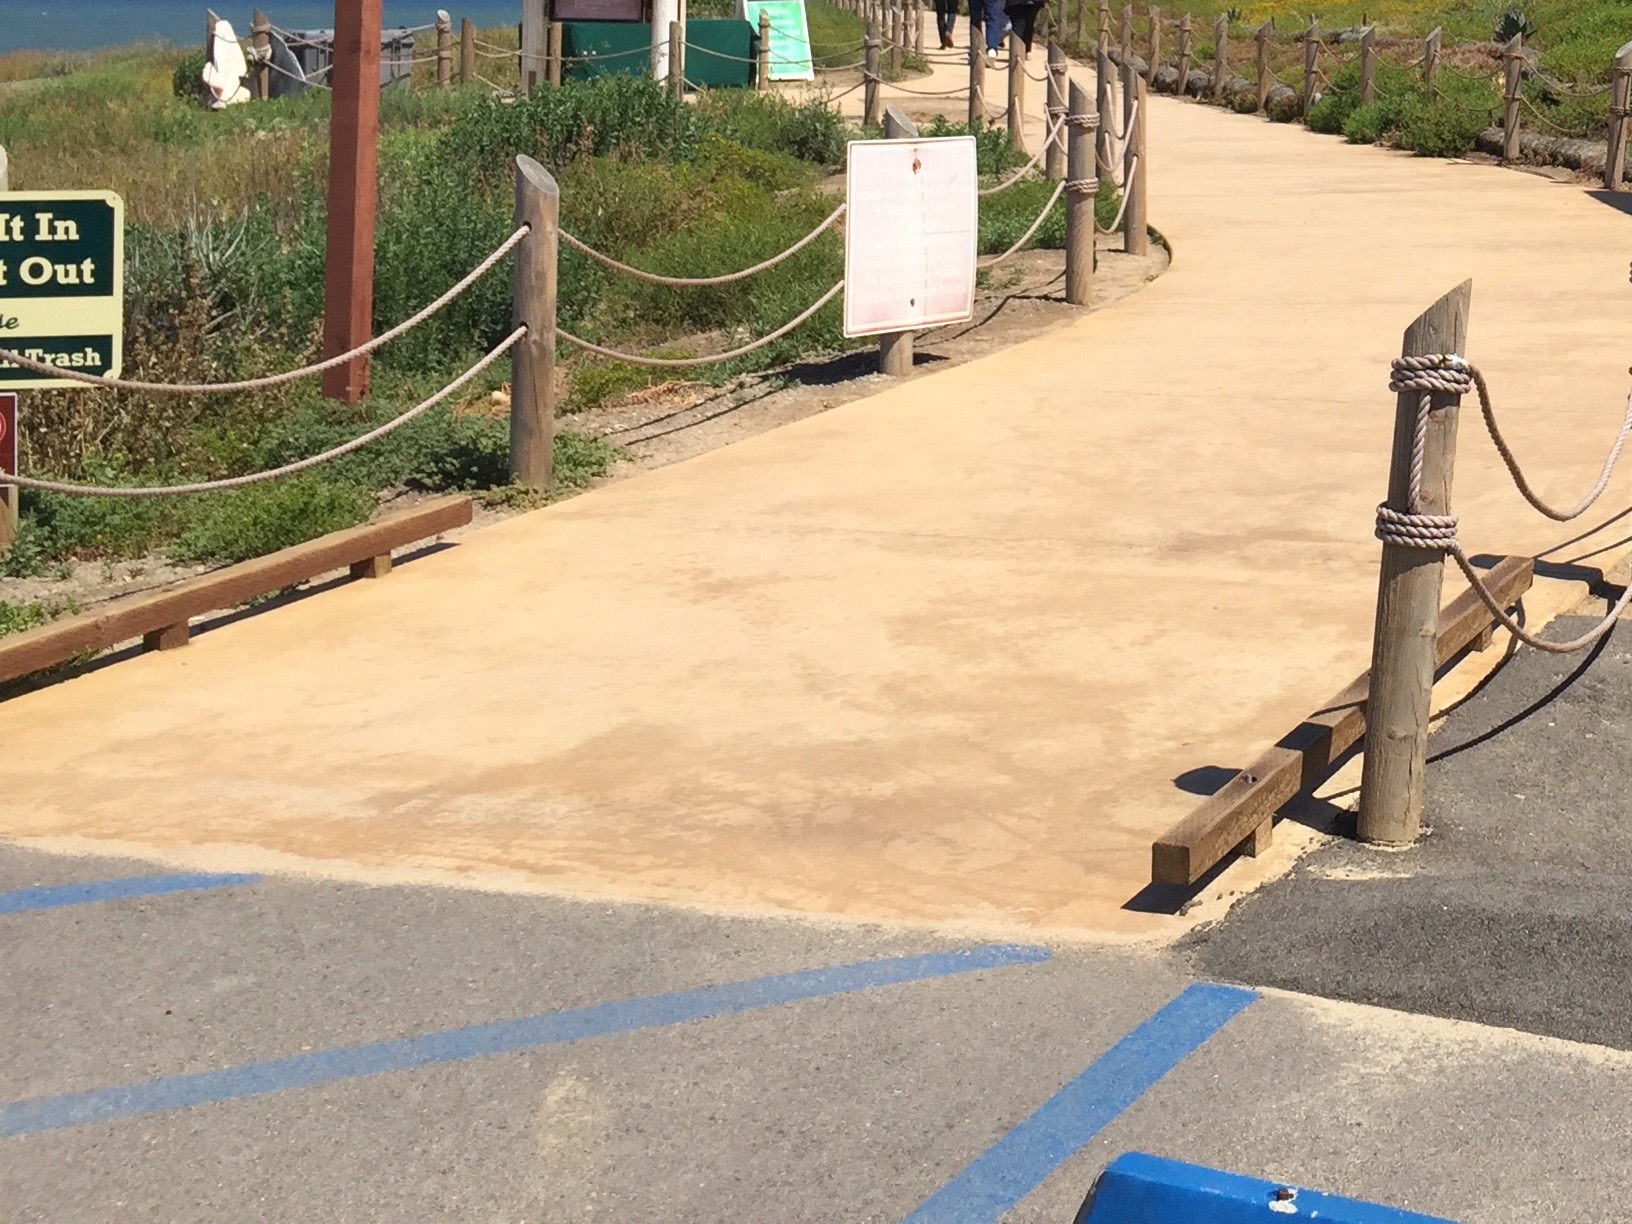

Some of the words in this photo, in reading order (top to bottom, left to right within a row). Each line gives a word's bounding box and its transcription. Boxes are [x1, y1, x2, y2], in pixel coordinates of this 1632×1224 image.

[34, 212, 80, 241] In
[19, 256, 95, 285] Out
[24, 347, 102, 368] Trash
